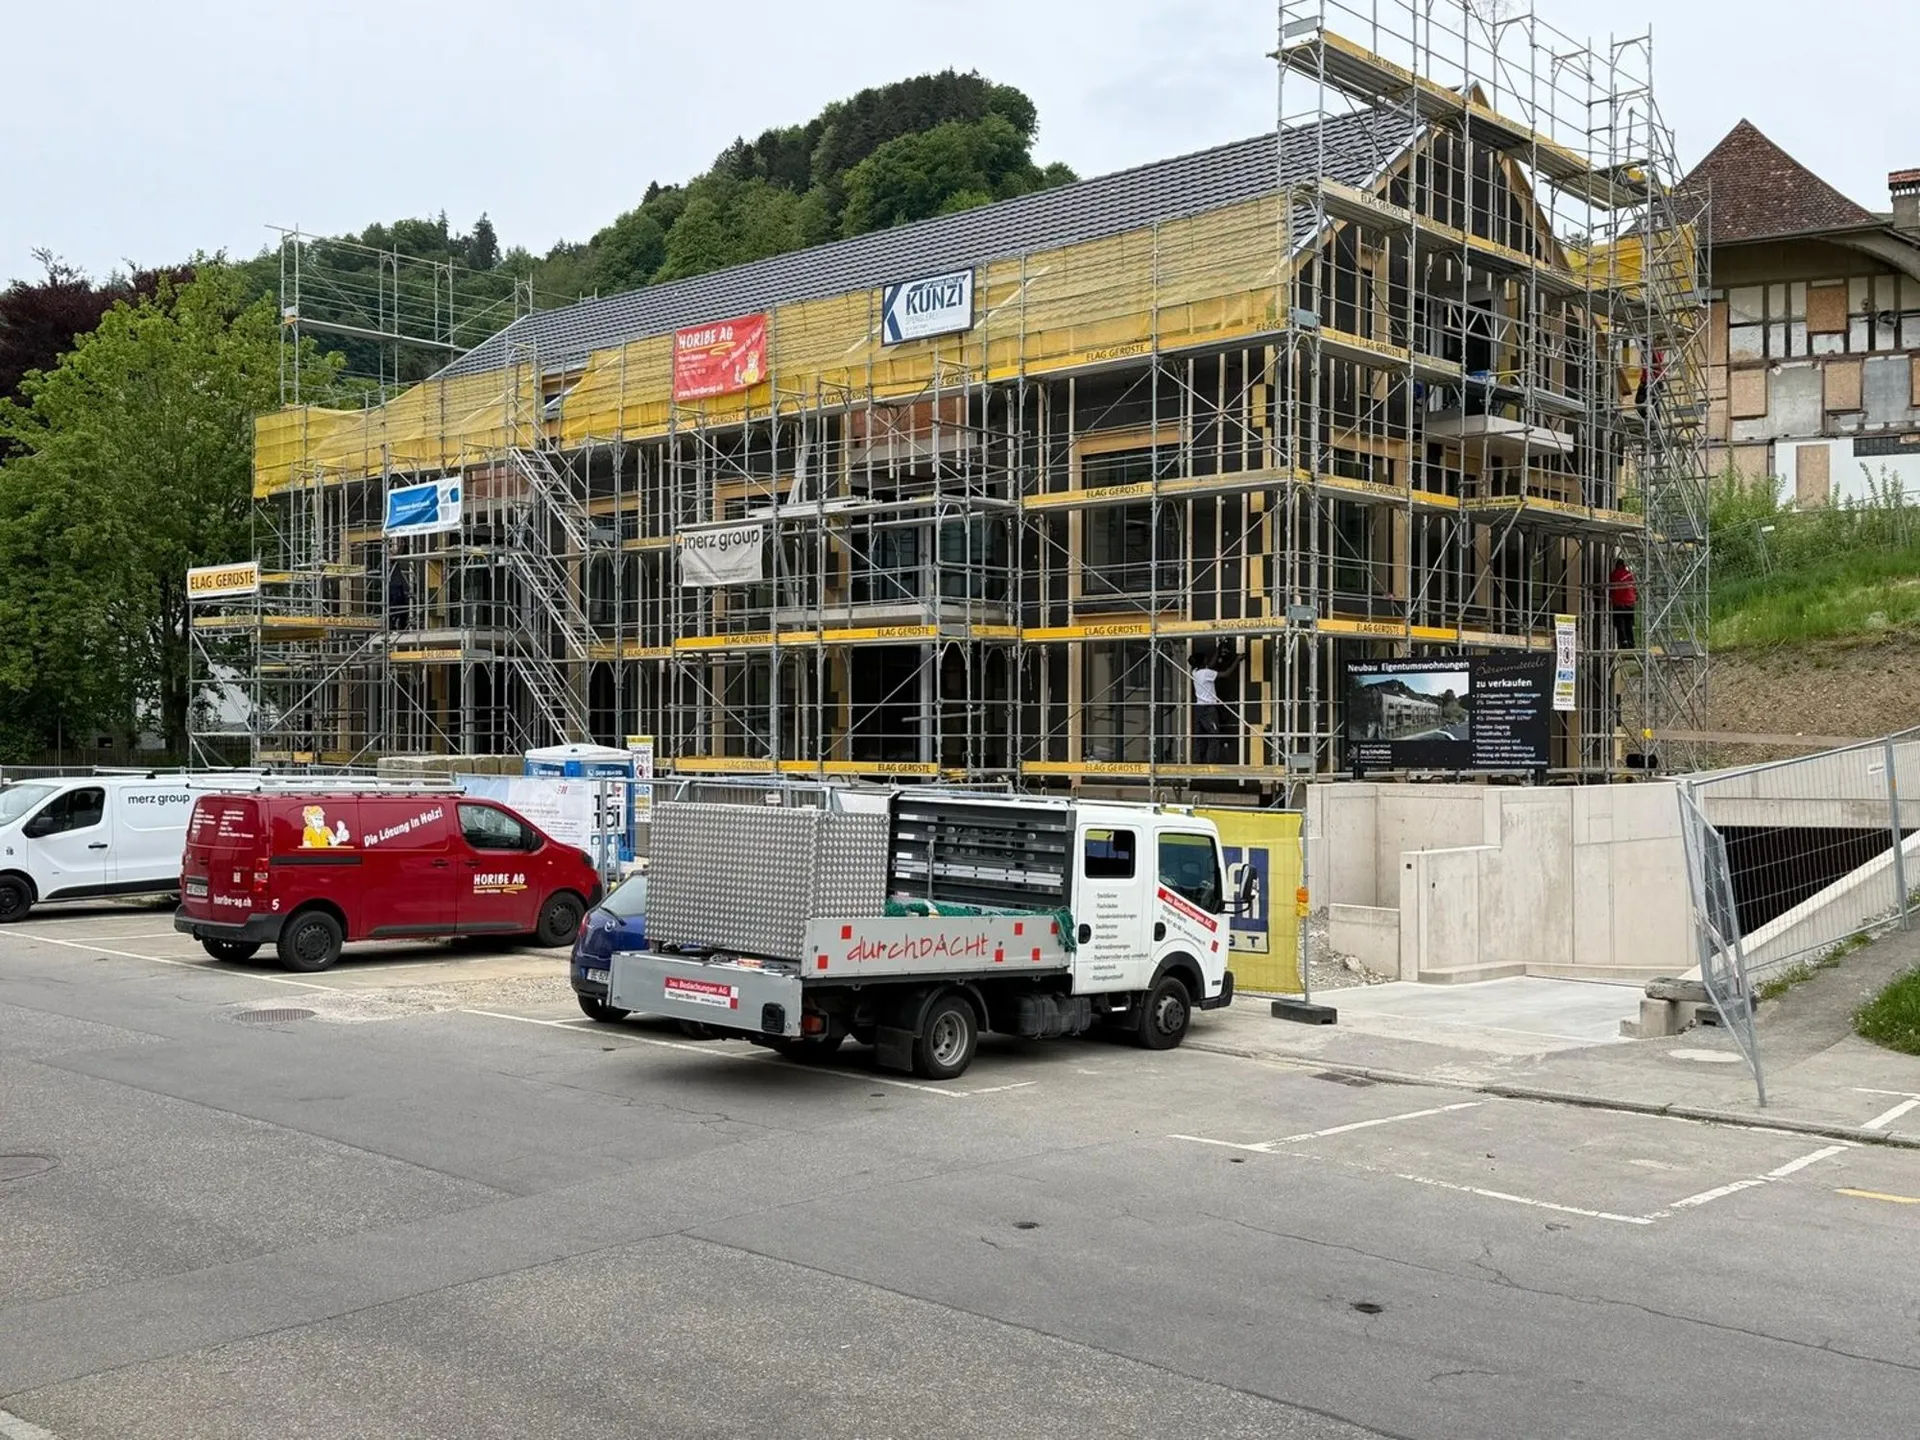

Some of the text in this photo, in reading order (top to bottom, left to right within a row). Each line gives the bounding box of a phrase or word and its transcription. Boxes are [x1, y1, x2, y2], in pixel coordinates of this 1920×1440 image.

[906, 283, 963, 315] KÜNZI
[1256, 319, 1281, 332] ELAG
[678, 326, 734, 349] HORIBE AG
[1358, 337, 1375, 350] ELAG
[1086, 343, 1145, 361] ELAG GERÜSTE
[1086, 484, 1145, 498] ELAG GERÜSTE
[683, 534, 716, 550] merz
[718, 529, 760, 552] group
[190, 570, 255, 590] ELAG GERÜSTE
[877, 627, 930, 637] ELAG GERÜSTE
[1085, 624, 1144, 635] ELAG GERÜSTE
[1355, 622, 1400, 635] ELAG GERÜSTE
[724, 636, 741, 645] ELAG
[1348, 660, 1470, 673] Neubau Eigentumswohnungen
[1475, 678, 1533, 689] zu verkaufen
[878, 763, 931, 773] ELAG GERÜSTE
[1085, 763, 1143, 773] ELAG GERÜSTE
[128, 794, 190, 806] merz group
[364, 806, 443, 847] Die Lösung in Holz!
[473, 873, 526, 885] HORIBE AG
[213, 893, 252, 908] horibe-ag.ch
[271, 898, 280, 910] 5
[679, 980, 717, 994] Bedachungen
[718, 986, 728, 995] AG
